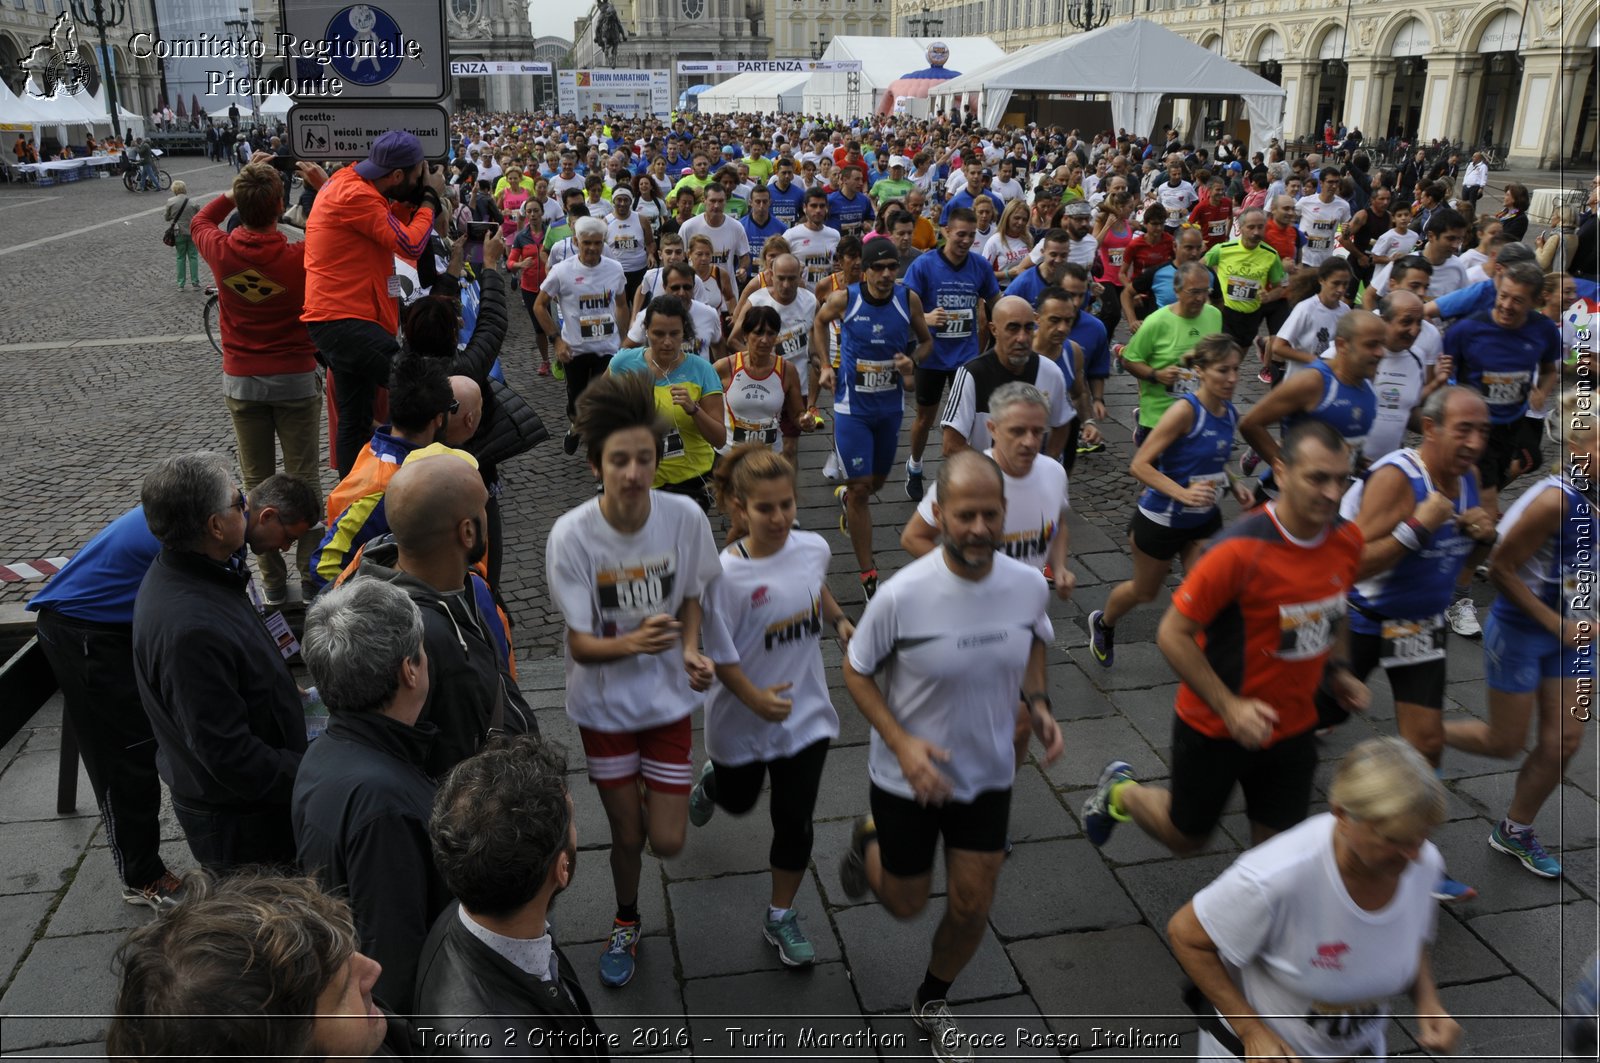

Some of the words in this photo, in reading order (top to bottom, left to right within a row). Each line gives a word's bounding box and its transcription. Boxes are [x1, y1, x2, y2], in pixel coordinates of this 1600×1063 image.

[452, 63, 488, 73] ENZA
[737, 61, 803, 72] PARTENZA
[592, 73, 612, 81] TURIN
[613, 73, 650, 81] MARATHON
[334, 128, 362, 137] veicoli
[618, 239, 635, 249] 1248
[1232, 285, 1250, 298] 561
[937, 294, 977, 308] ESERCITO
[591, 324, 605, 337] 90
[946, 320, 964, 333] 277
[782, 337, 801, 354] 937
[863, 371, 892, 387] 1052
[616, 577, 663, 609] 590
